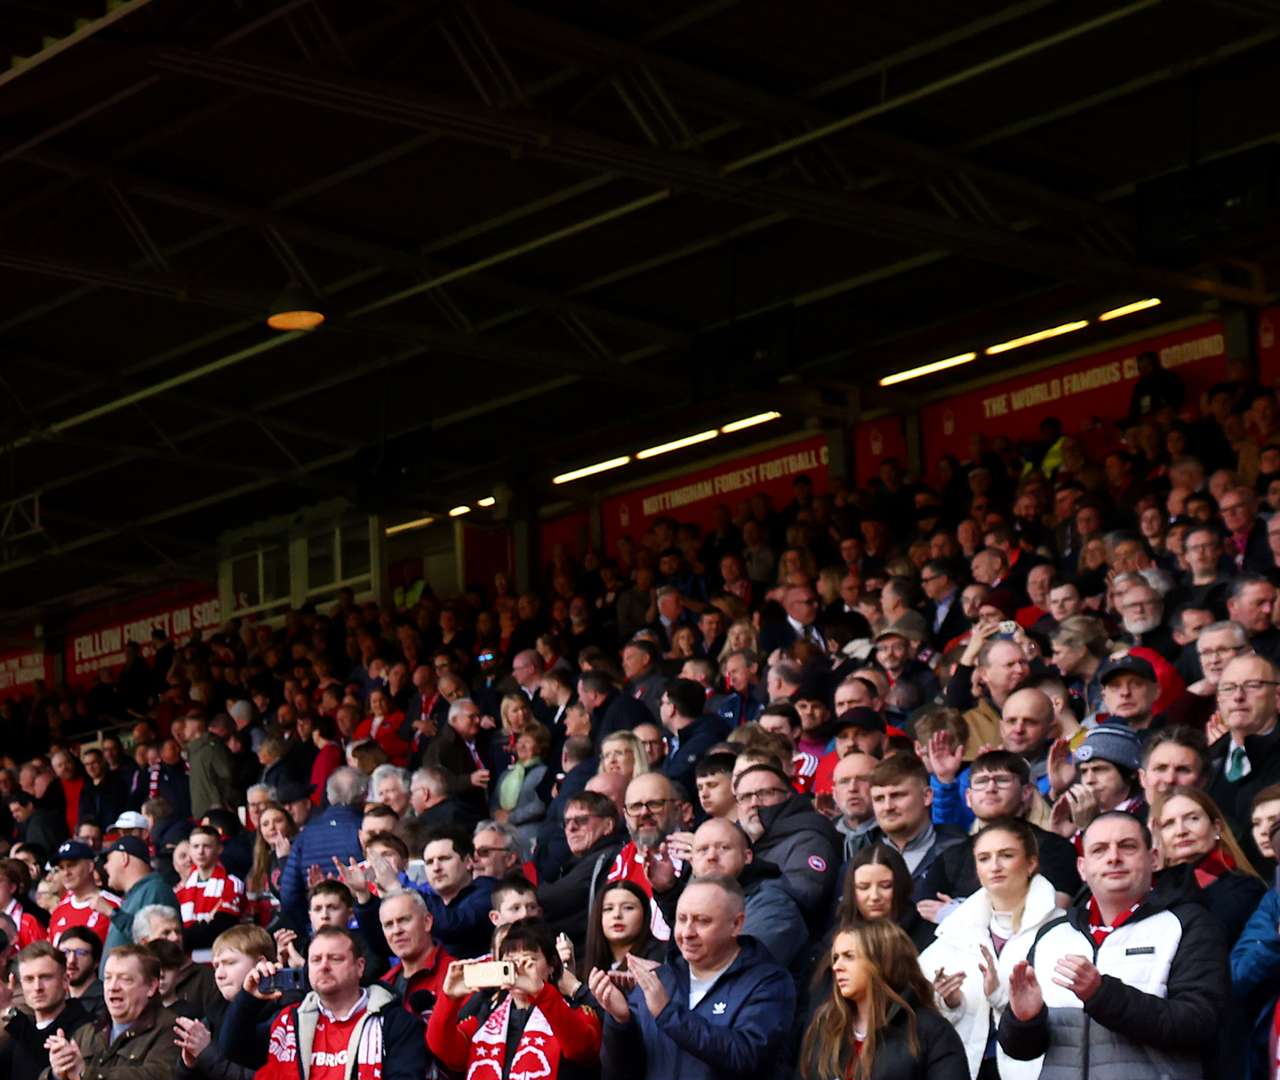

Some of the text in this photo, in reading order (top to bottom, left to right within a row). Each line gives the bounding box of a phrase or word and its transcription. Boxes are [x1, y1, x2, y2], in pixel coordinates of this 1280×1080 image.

[984, 392, 1009, 418] THE
[1011, 379, 1061, 411] WORLD
[1063, 361, 1121, 396] FAMOUS
[1160, 334, 1224, 369] GROUND
[643, 480, 713, 516] NOTTINGHAM
[715, 465, 758, 494] FOREST
[760, 450, 818, 481] FOOTBALL
[74, 626, 122, 662] FOLLOW
[172, 607, 191, 635] ON
[192, 599, 221, 629] SOC
